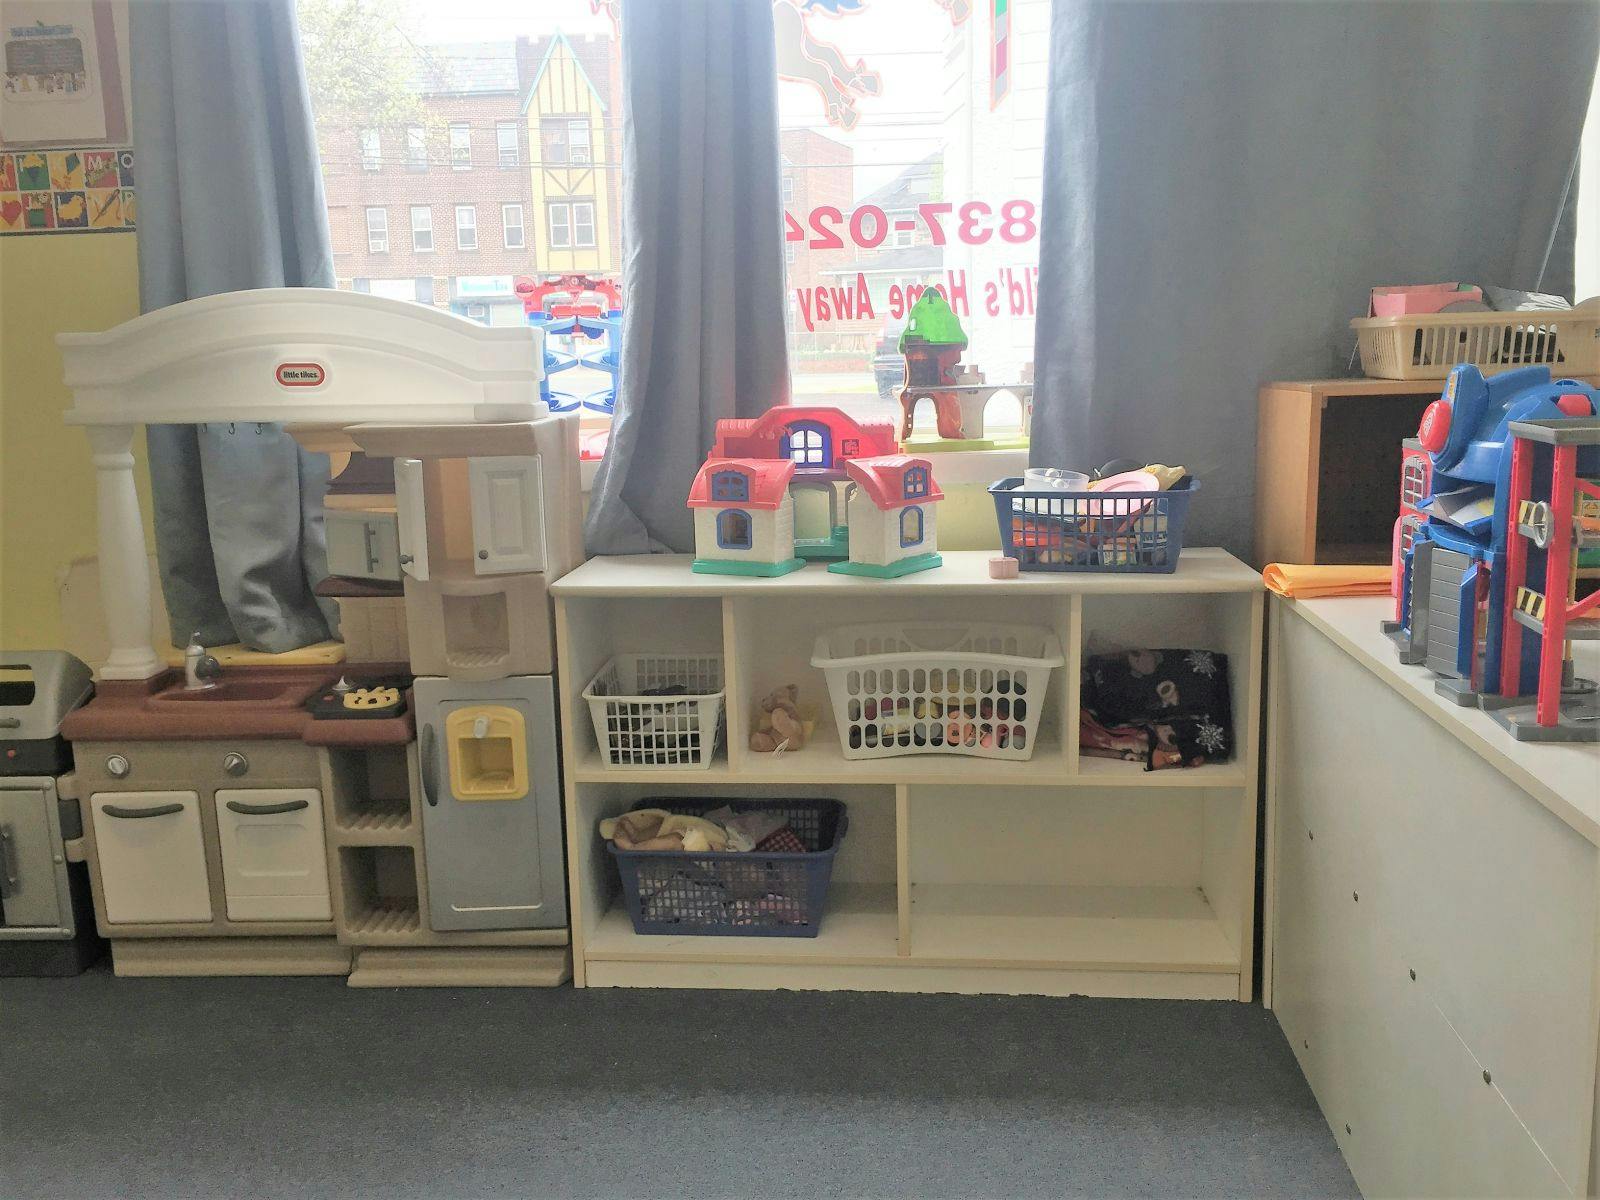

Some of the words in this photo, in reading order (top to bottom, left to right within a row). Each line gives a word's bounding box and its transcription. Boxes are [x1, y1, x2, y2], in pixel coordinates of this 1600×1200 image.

[88, 154, 103, 171] M
[120, 153, 134, 169] O
[283, 370, 299, 378] little
[300, 370, 318, 378] tikes
